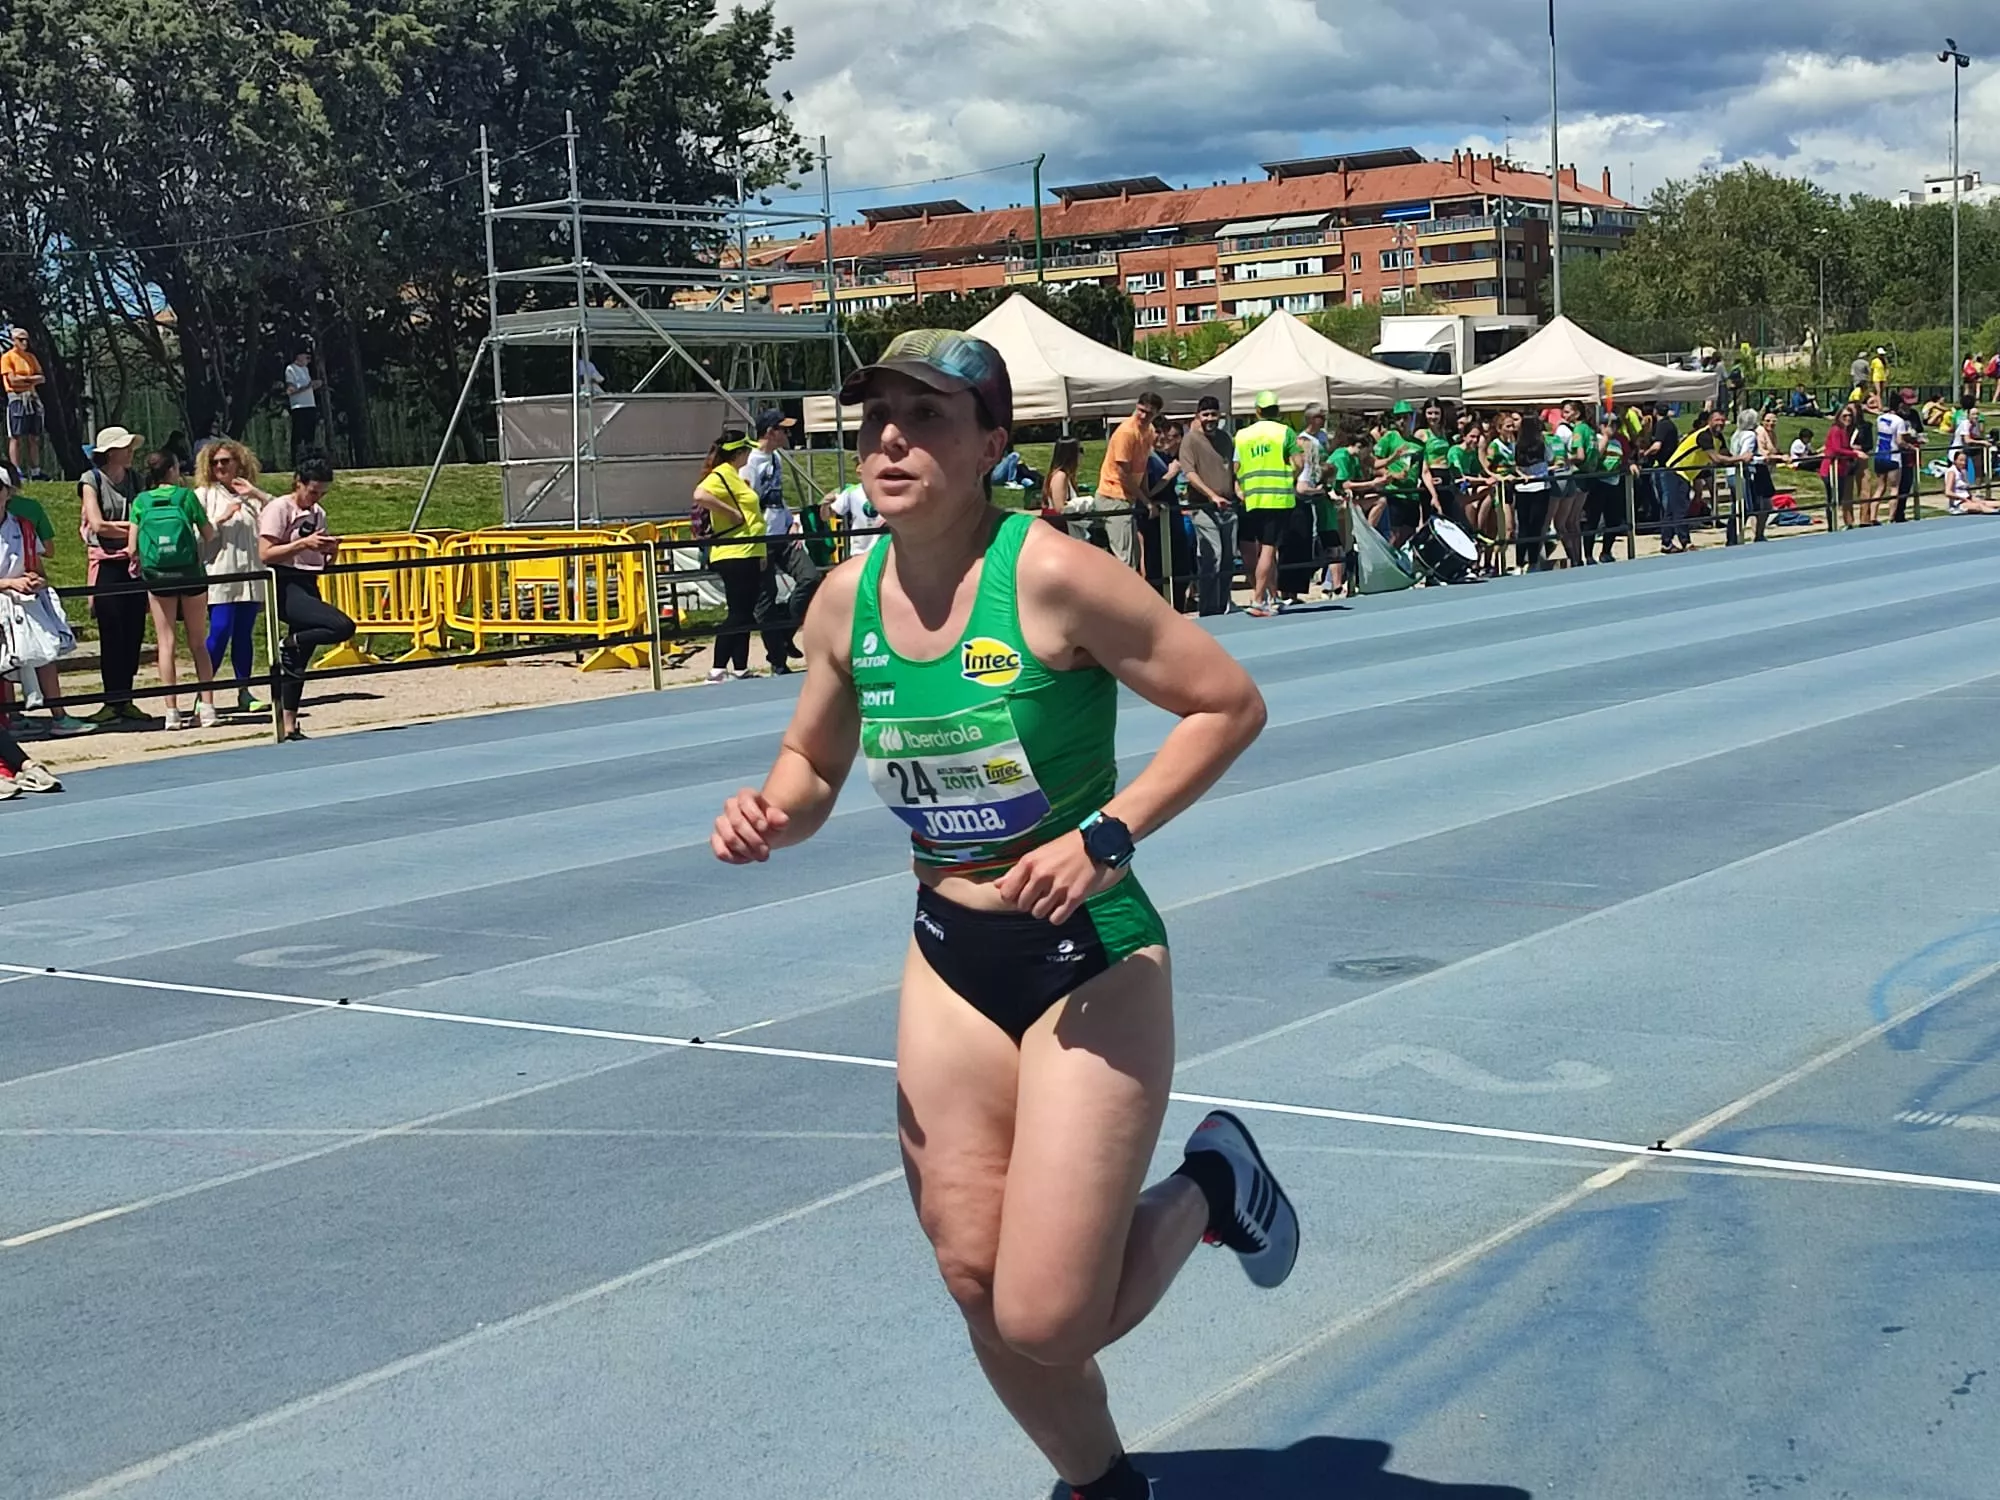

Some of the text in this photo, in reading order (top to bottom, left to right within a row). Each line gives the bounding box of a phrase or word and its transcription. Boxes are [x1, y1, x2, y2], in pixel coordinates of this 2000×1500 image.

[903, 724, 983, 749] Iberdrola
[887, 760, 939, 805] 24
[941, 774, 985, 790] ZOITI
[234, 945, 442, 975] 5
